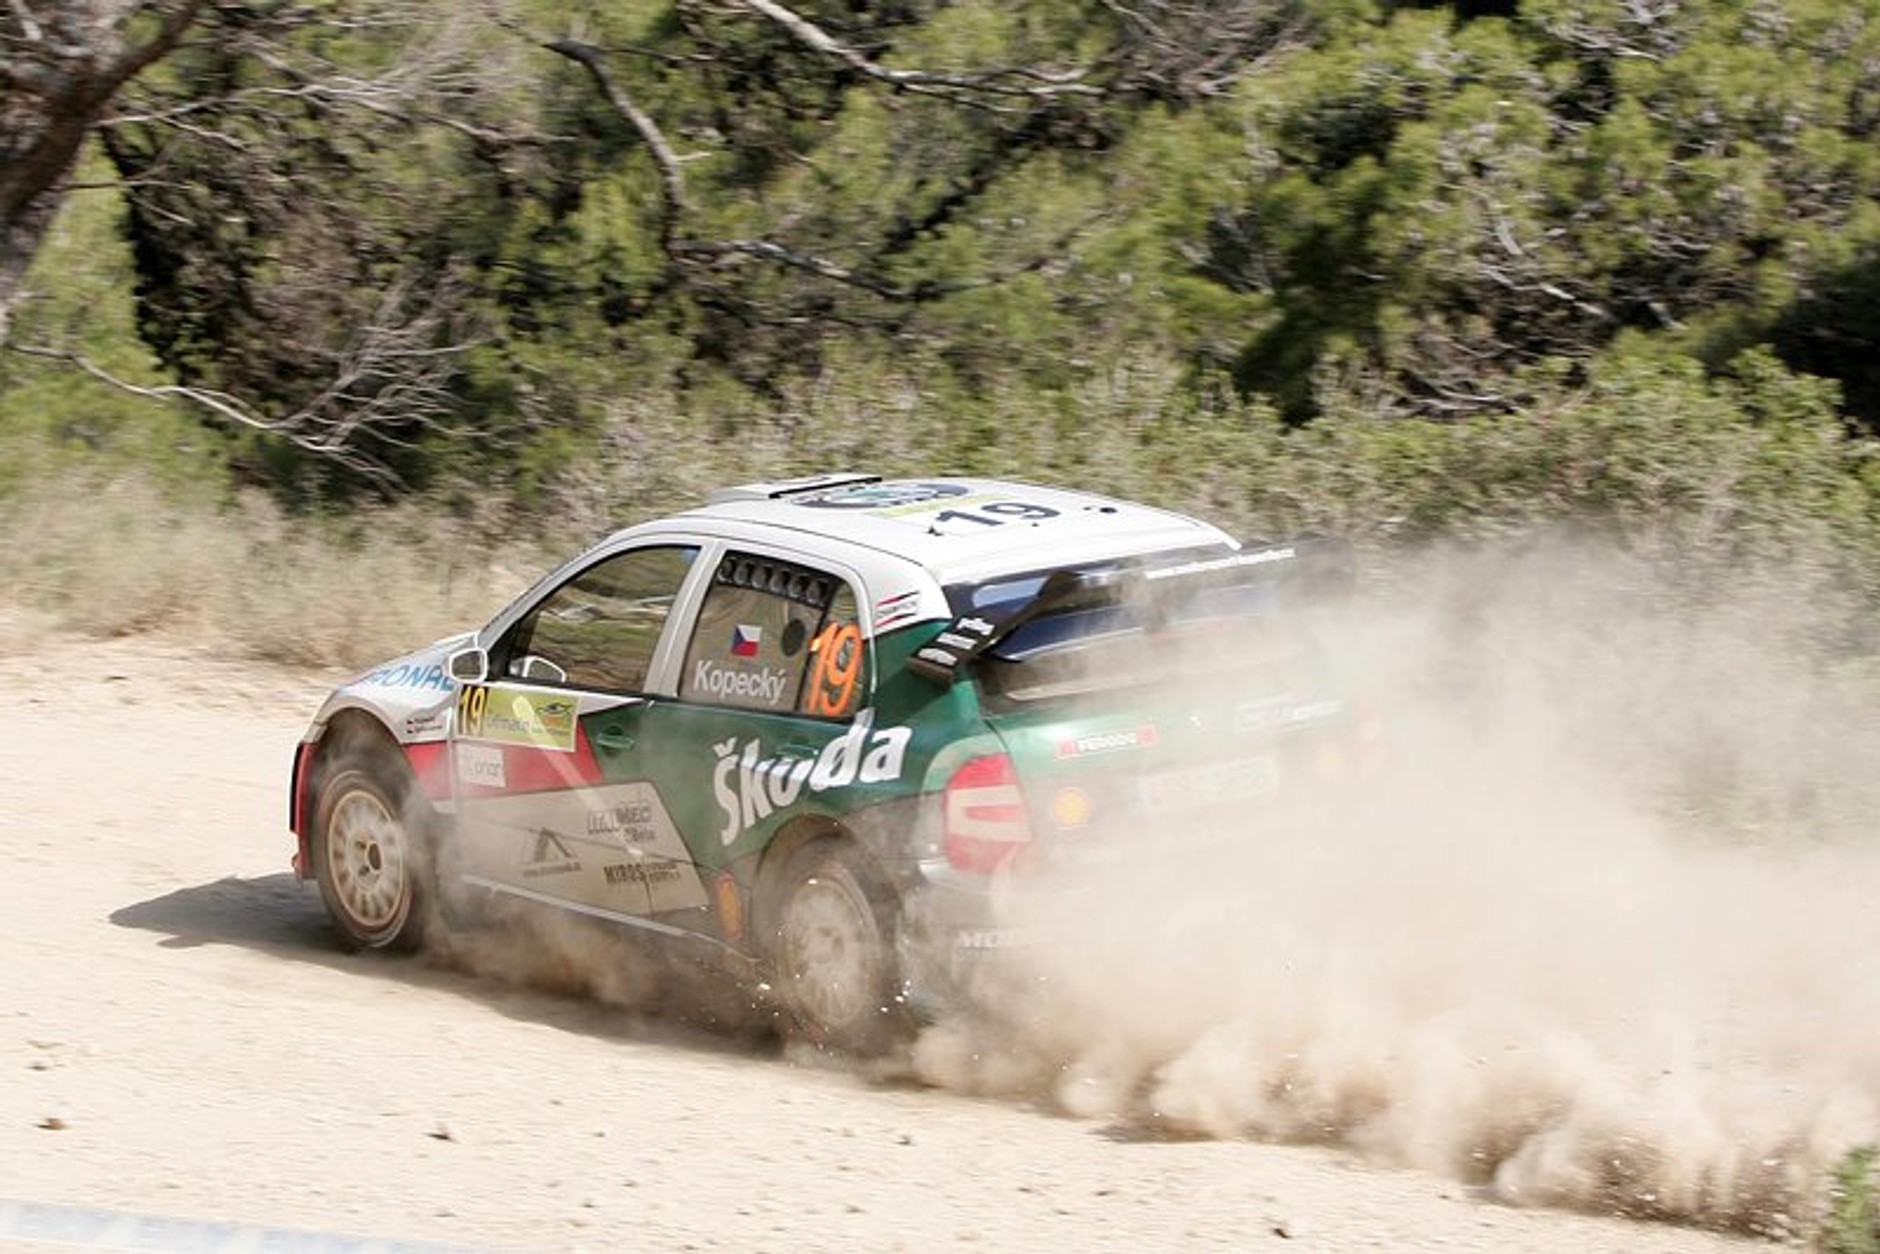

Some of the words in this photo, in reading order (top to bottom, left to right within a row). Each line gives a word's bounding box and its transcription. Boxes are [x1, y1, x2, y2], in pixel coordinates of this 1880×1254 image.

[936, 502, 1062, 528] 19
[694, 660, 787, 704] Kopecký
[807, 621, 864, 718] 19
[460, 685, 486, 735] 19
[713, 707, 912, 846] Škoda
